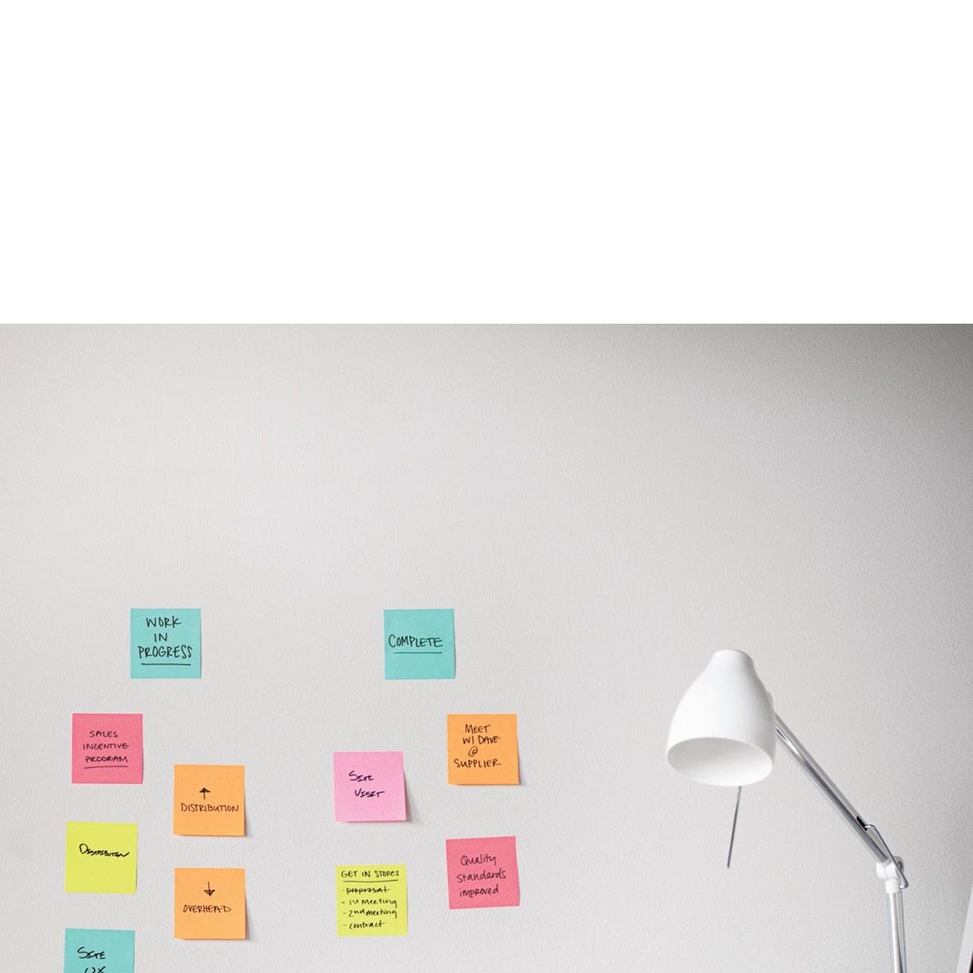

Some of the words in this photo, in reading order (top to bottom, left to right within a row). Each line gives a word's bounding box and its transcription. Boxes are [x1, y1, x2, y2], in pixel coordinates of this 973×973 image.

[145, 615, 182, 629] WORK
[153, 632, 168, 643] IN
[388, 633, 444, 648] COMPLETE
[137, 644, 193, 660] PROGRESS
[89, 730, 119, 738] SALES
[464, 723, 492, 735] MEET
[477, 734, 500, 745] DAVE
[82, 742, 130, 751] INCENTIVE
[467, 745, 479, 758] @
[85, 755, 129, 763] PROGRAM
[453, 758, 502, 769] SUPPLIER
[180, 802, 240, 813] DISTRIBUTION
[460, 853, 497, 867] Quality
[340, 870, 359, 879] GET
[361, 870, 372, 879] IN
[458, 885, 500, 899] improved
[182, 904, 232, 914] OVERHEAD
[348, 919, 385, 930] contract
